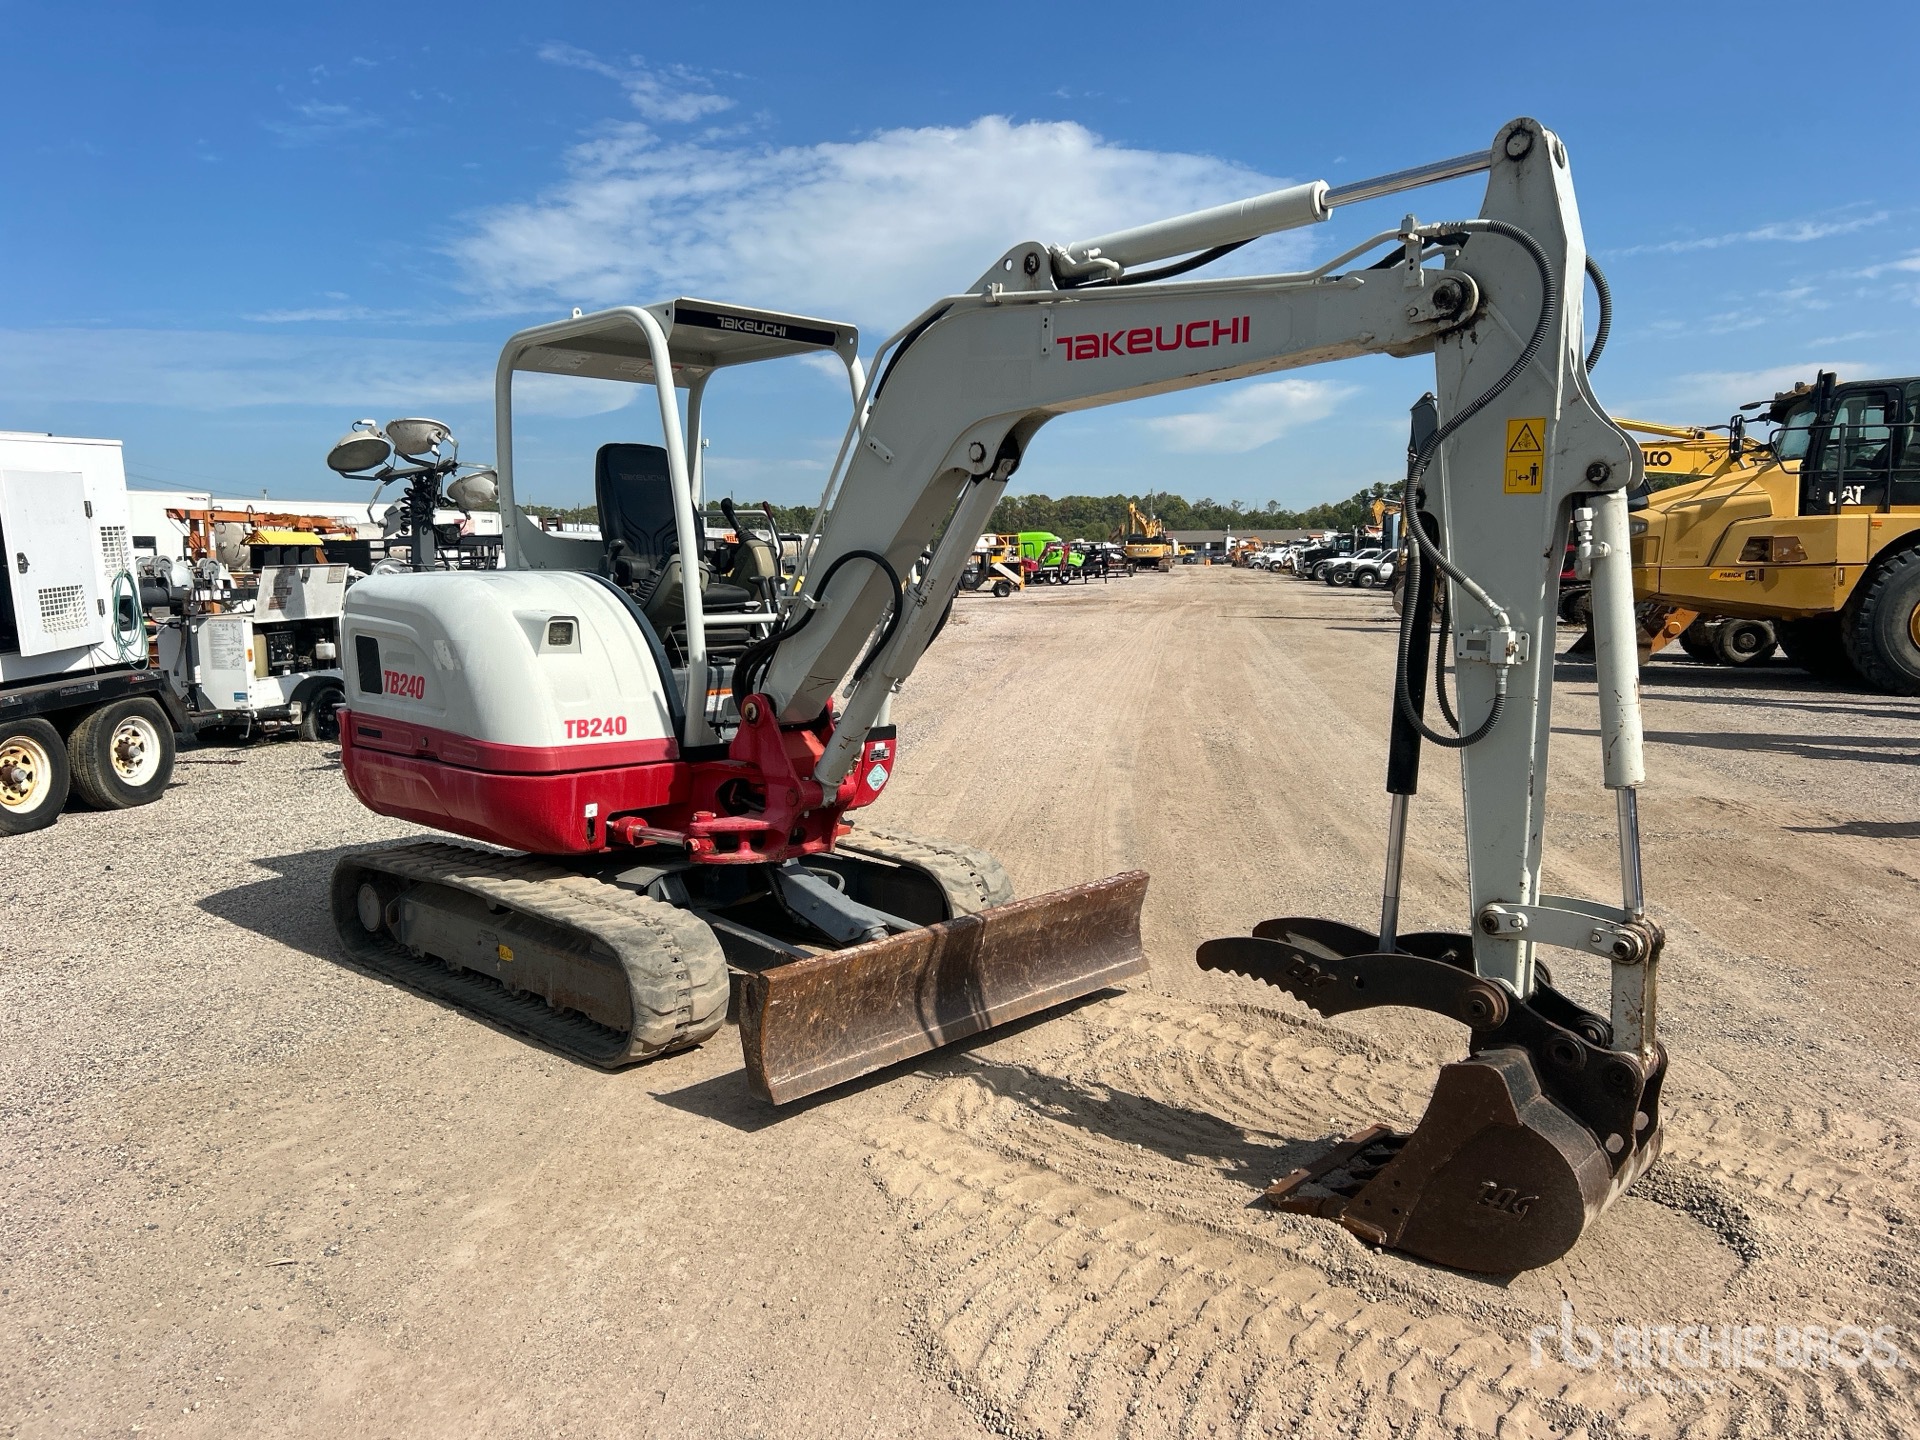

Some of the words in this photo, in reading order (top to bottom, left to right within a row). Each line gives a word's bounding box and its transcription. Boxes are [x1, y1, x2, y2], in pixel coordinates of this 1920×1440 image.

[717, 316, 787, 337] TAKEUCHI
[1056, 316, 1250, 361] TAKEUCHI
[384, 670, 426, 700] TB240
[564, 716, 627, 739] TB240
